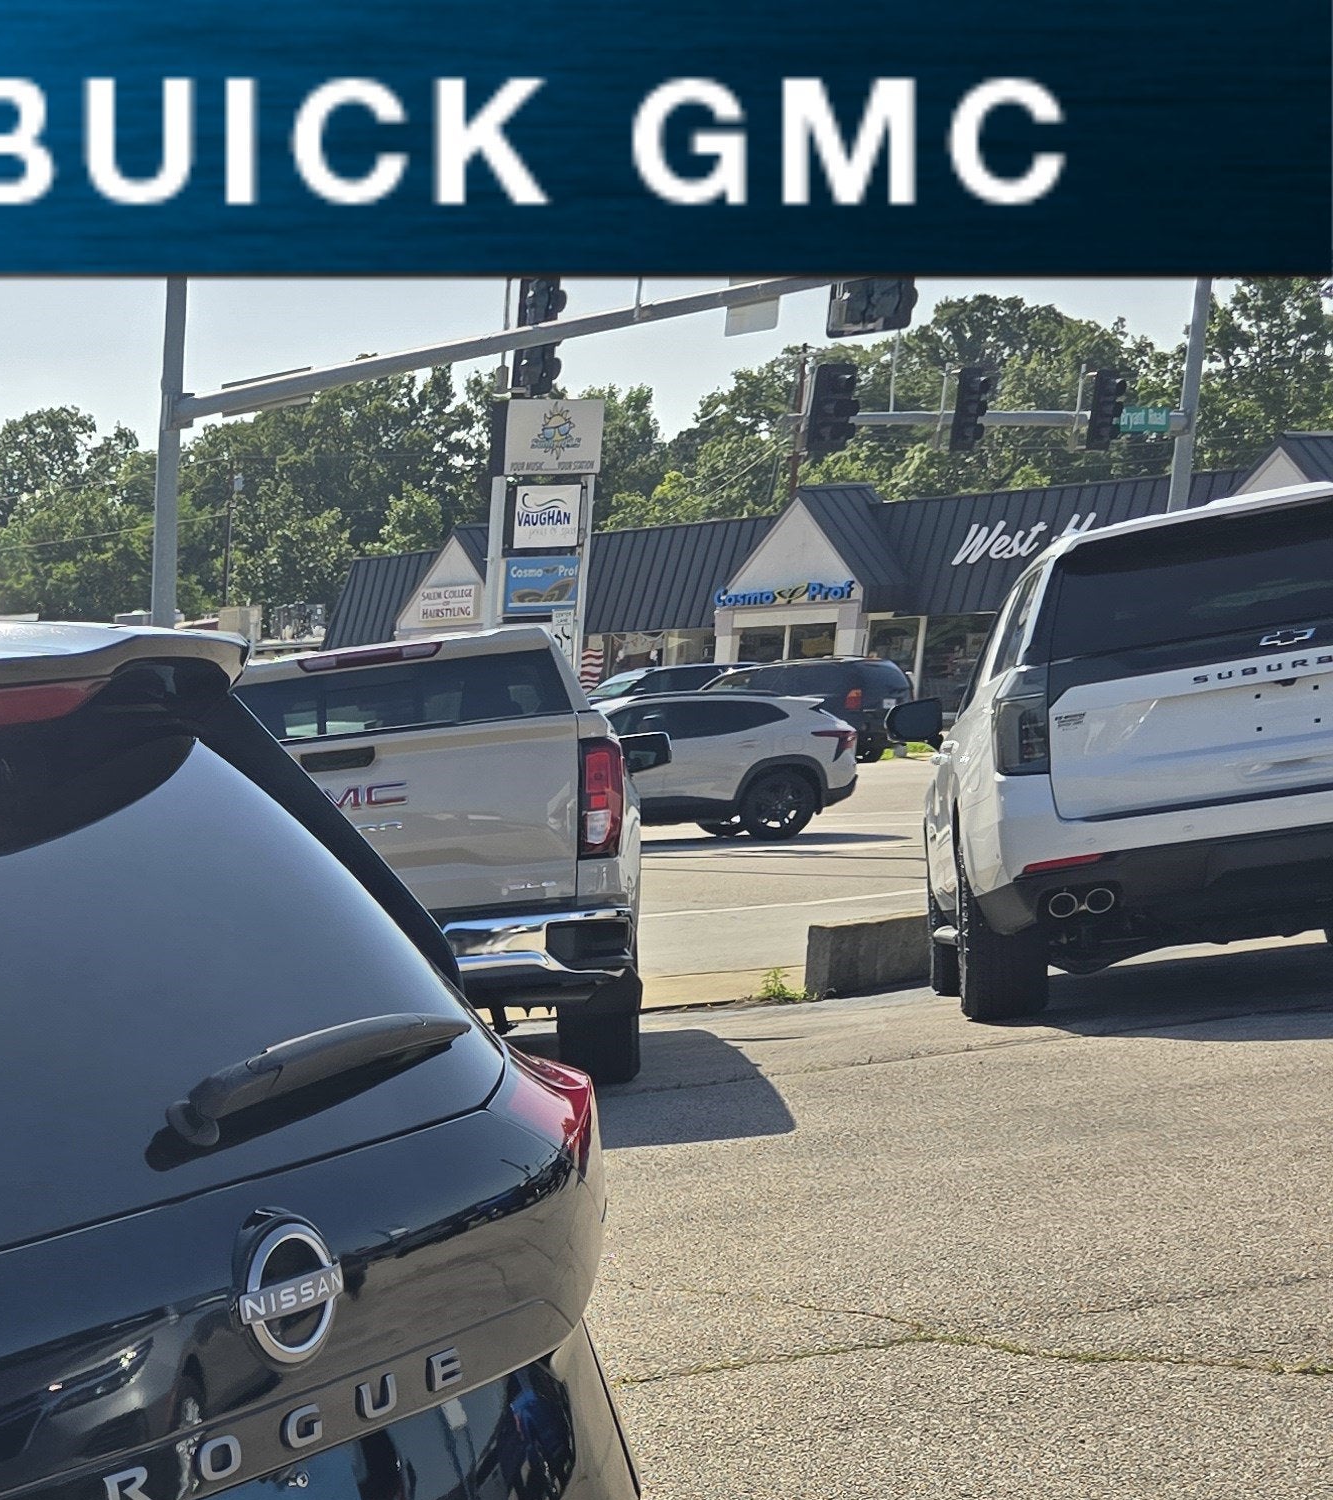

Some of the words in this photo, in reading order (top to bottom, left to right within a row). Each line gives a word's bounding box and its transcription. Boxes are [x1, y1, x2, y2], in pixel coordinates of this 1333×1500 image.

[517, 511, 571, 527] VAUGHAN
[951, 520, 1047, 566] West
[510, 566, 544, 578] Cosmo
[558, 564, 579, 577] Prof
[444, 588, 472, 599] COLLEGE
[714, 586, 775, 607] Cosmo
[807, 580, 854, 600] Prof
[421, 606, 471, 619] HAIRSTYLING
[323, 780, 409, 810] MC
[244, 1271, 343, 1321] NISSAN
